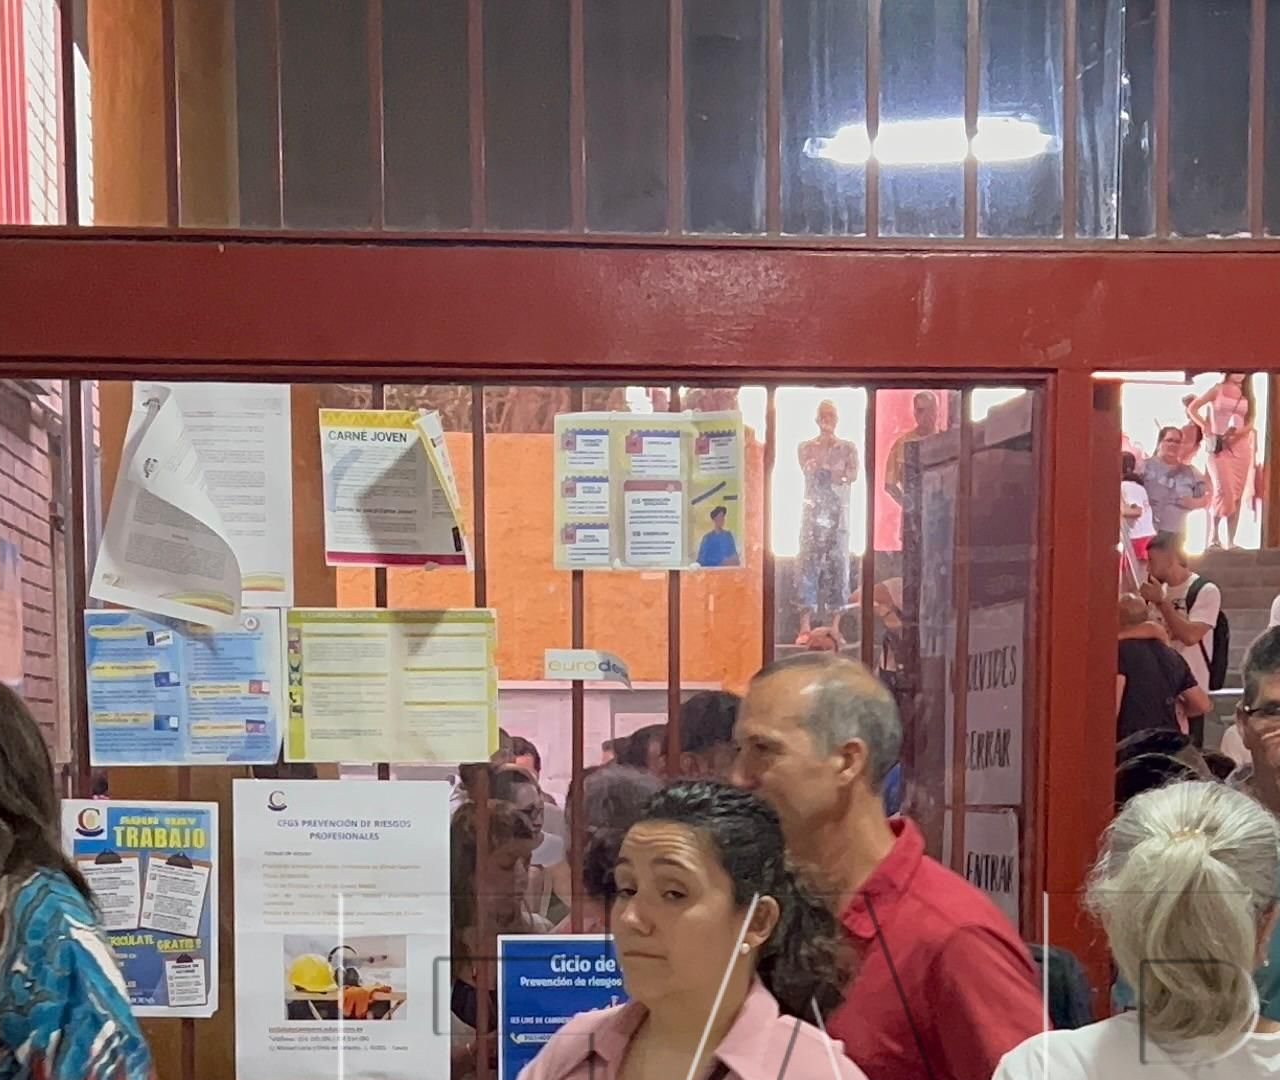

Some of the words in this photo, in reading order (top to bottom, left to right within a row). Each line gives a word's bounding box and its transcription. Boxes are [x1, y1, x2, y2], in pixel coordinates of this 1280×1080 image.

[328, 429, 368, 441] CARNÉ
[370, 431, 407, 442] JOVEN
[966, 728, 1011, 770] ERRAR
[301, 819, 358, 829] PREVENCIÓN
[360, 820, 371, 828] DE
[374, 820, 412, 829] RIESGOS
[113, 826, 206, 849] TRABAJO
[309, 832, 380, 842] PROFESIONALES
[550, 954, 591, 973] Ciclo
[595, 955, 616, 973] de
[520, 976, 573, 987] Prevención
[574, 977, 587, 987] de
[588, 976, 623, 989] riesgos
